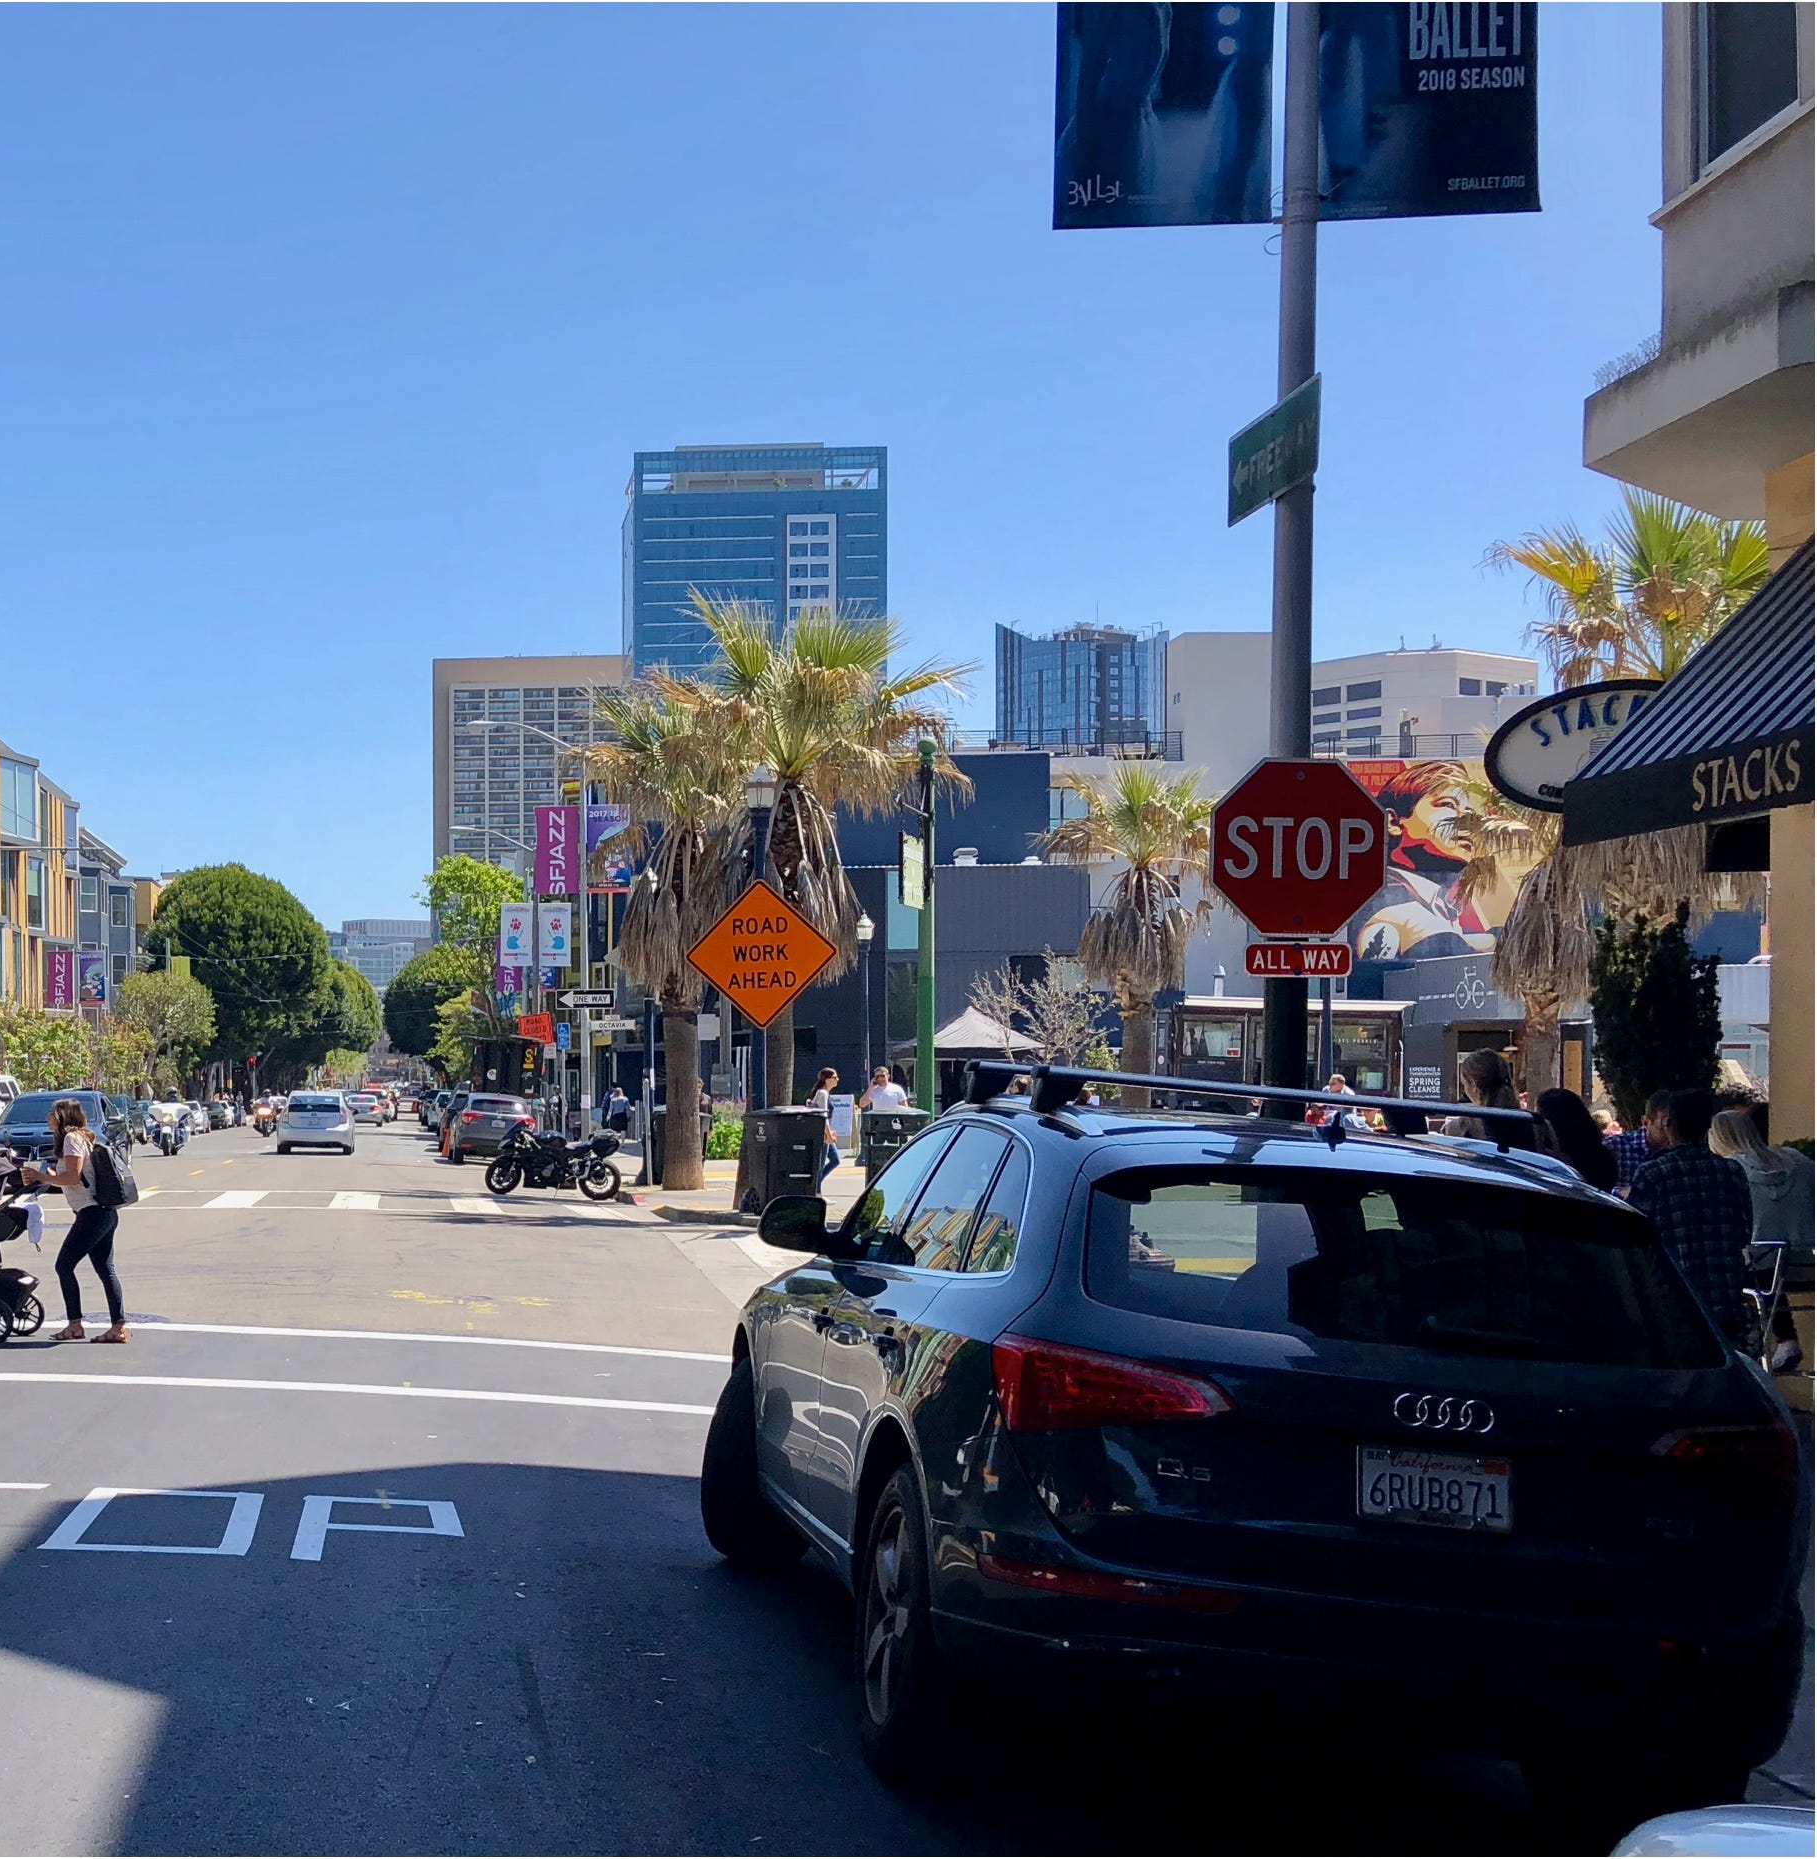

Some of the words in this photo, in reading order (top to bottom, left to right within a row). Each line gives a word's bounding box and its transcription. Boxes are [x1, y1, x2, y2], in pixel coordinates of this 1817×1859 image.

[1418, 69, 1457, 91] 2018
[1460, 66, 1525, 89] SEASON
[1448, 175, 1526, 191] SFBALLET.ORG
[1692, 739, 1801, 812] STACKS
[549, 810, 565, 894] SFJAZZ
[1224, 816, 1374, 880] STOP
[733, 917, 788, 936] ROAD
[733, 944, 789, 962] WORK
[1253, 951, 1291, 970] ALL
[1303, 951, 1342, 970] WAY
[55, 953, 65, 1005] SFJAZZ
[727, 971, 797, 990] AHEAD
[1369, 1472, 1503, 1519] 6RUB871
